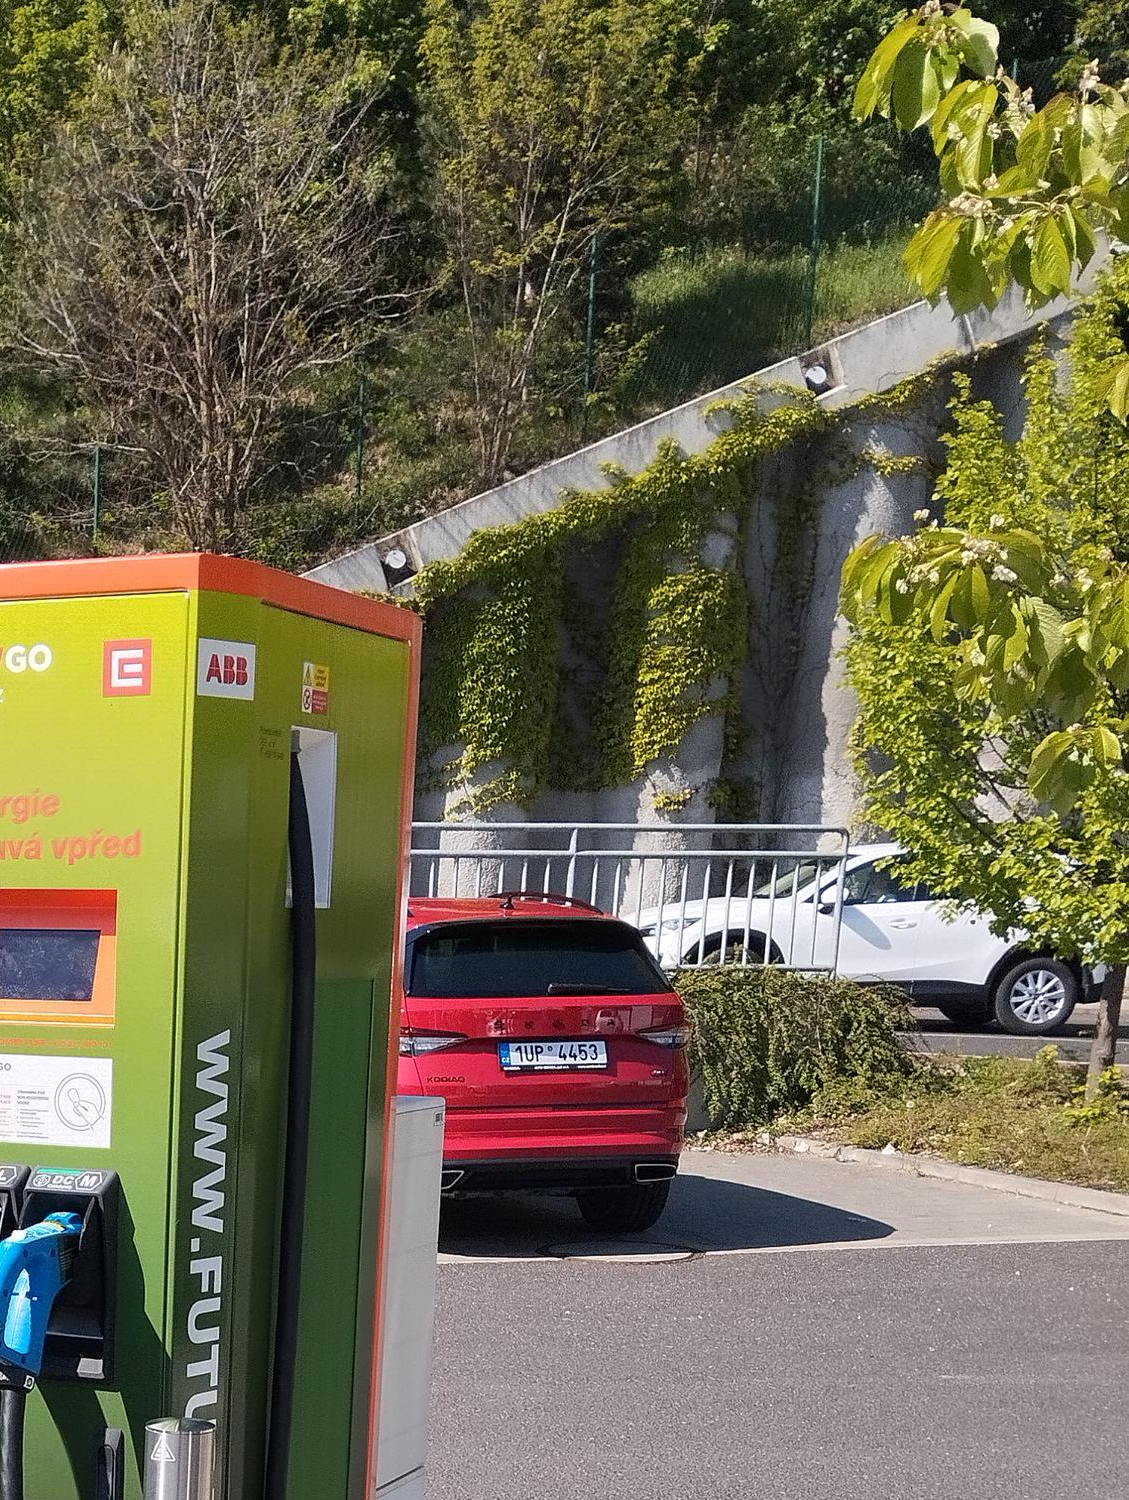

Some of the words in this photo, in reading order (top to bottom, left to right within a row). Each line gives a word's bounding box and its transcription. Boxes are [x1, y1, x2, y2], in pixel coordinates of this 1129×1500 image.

[206, 654, 248, 685] ABB
[53, 829, 143, 866] vpřed
[515, 1046, 544, 1063] 1UP
[558, 1044, 599, 1062] 4453
[52, 1175, 74, 1185] DC
[78, 1175, 97, 1187] M
